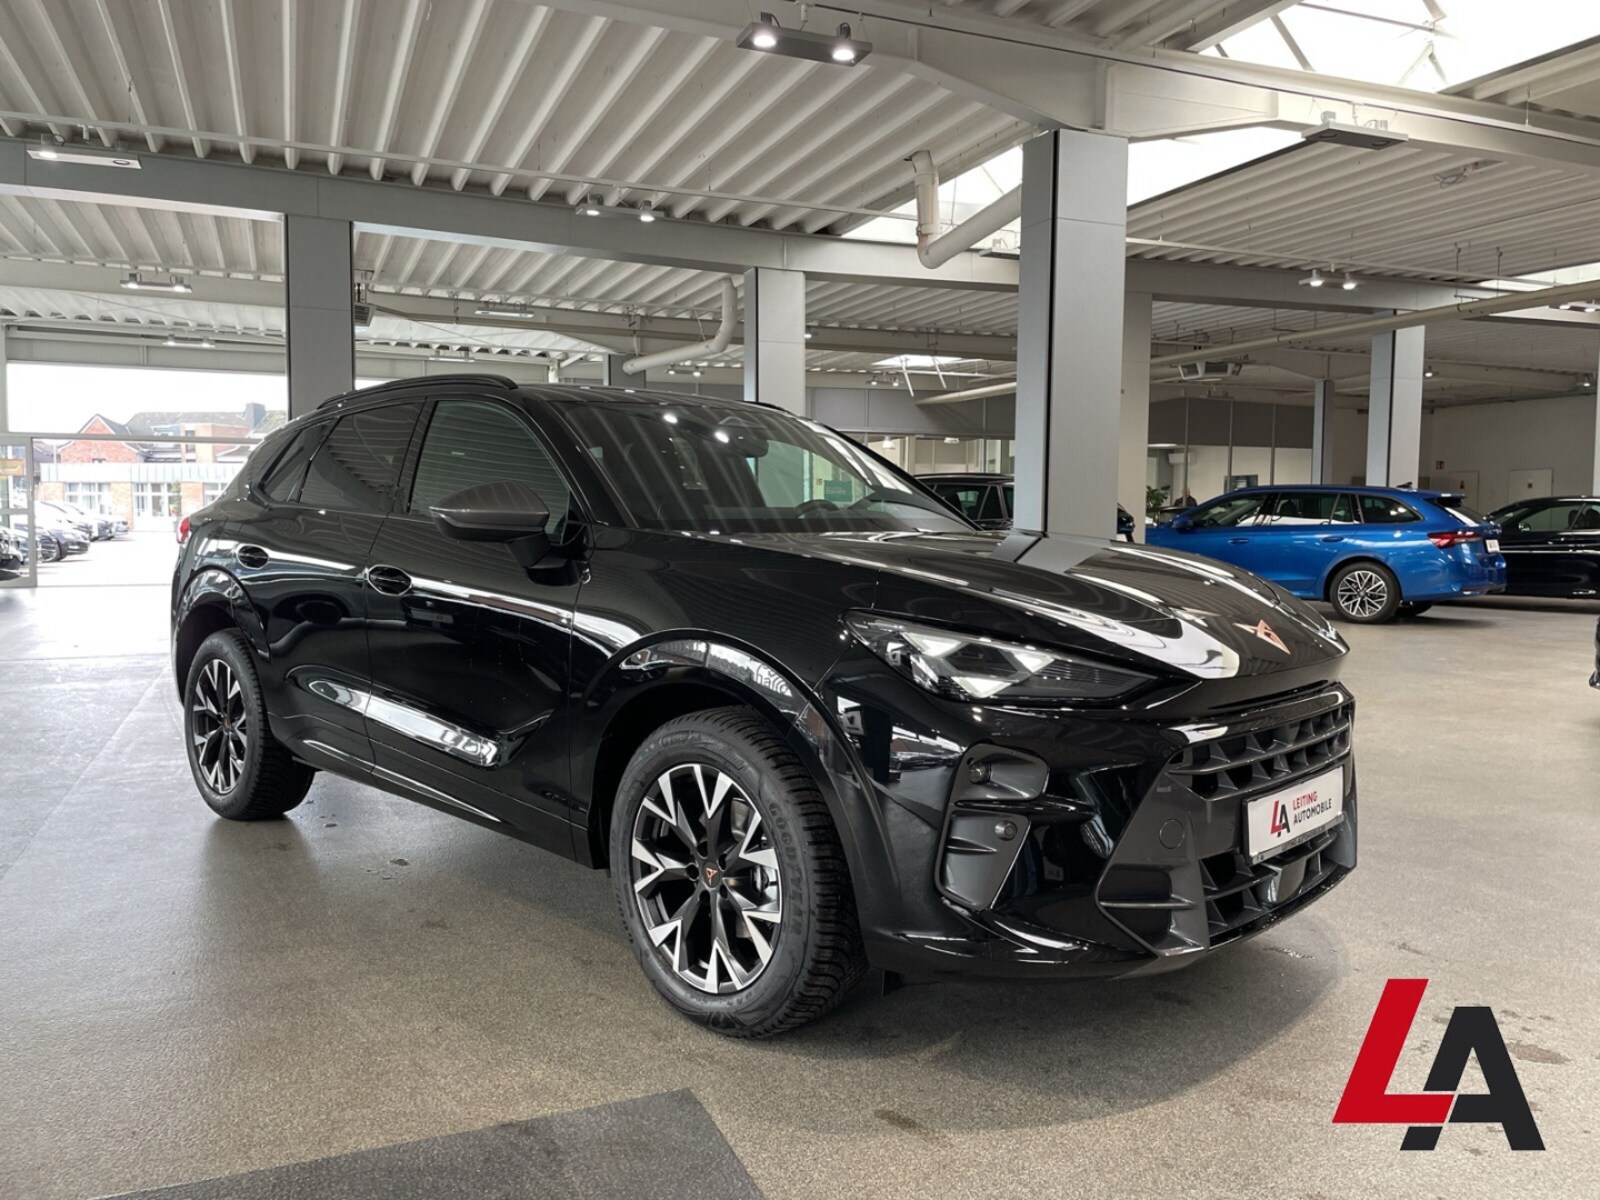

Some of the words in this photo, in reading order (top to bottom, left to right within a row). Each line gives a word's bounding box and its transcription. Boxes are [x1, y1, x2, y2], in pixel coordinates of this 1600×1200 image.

[1293, 791, 1317, 811] LEITING
[1293, 798, 1332, 825] AUTOMOBILE
[1271, 800, 1290, 837] LA
